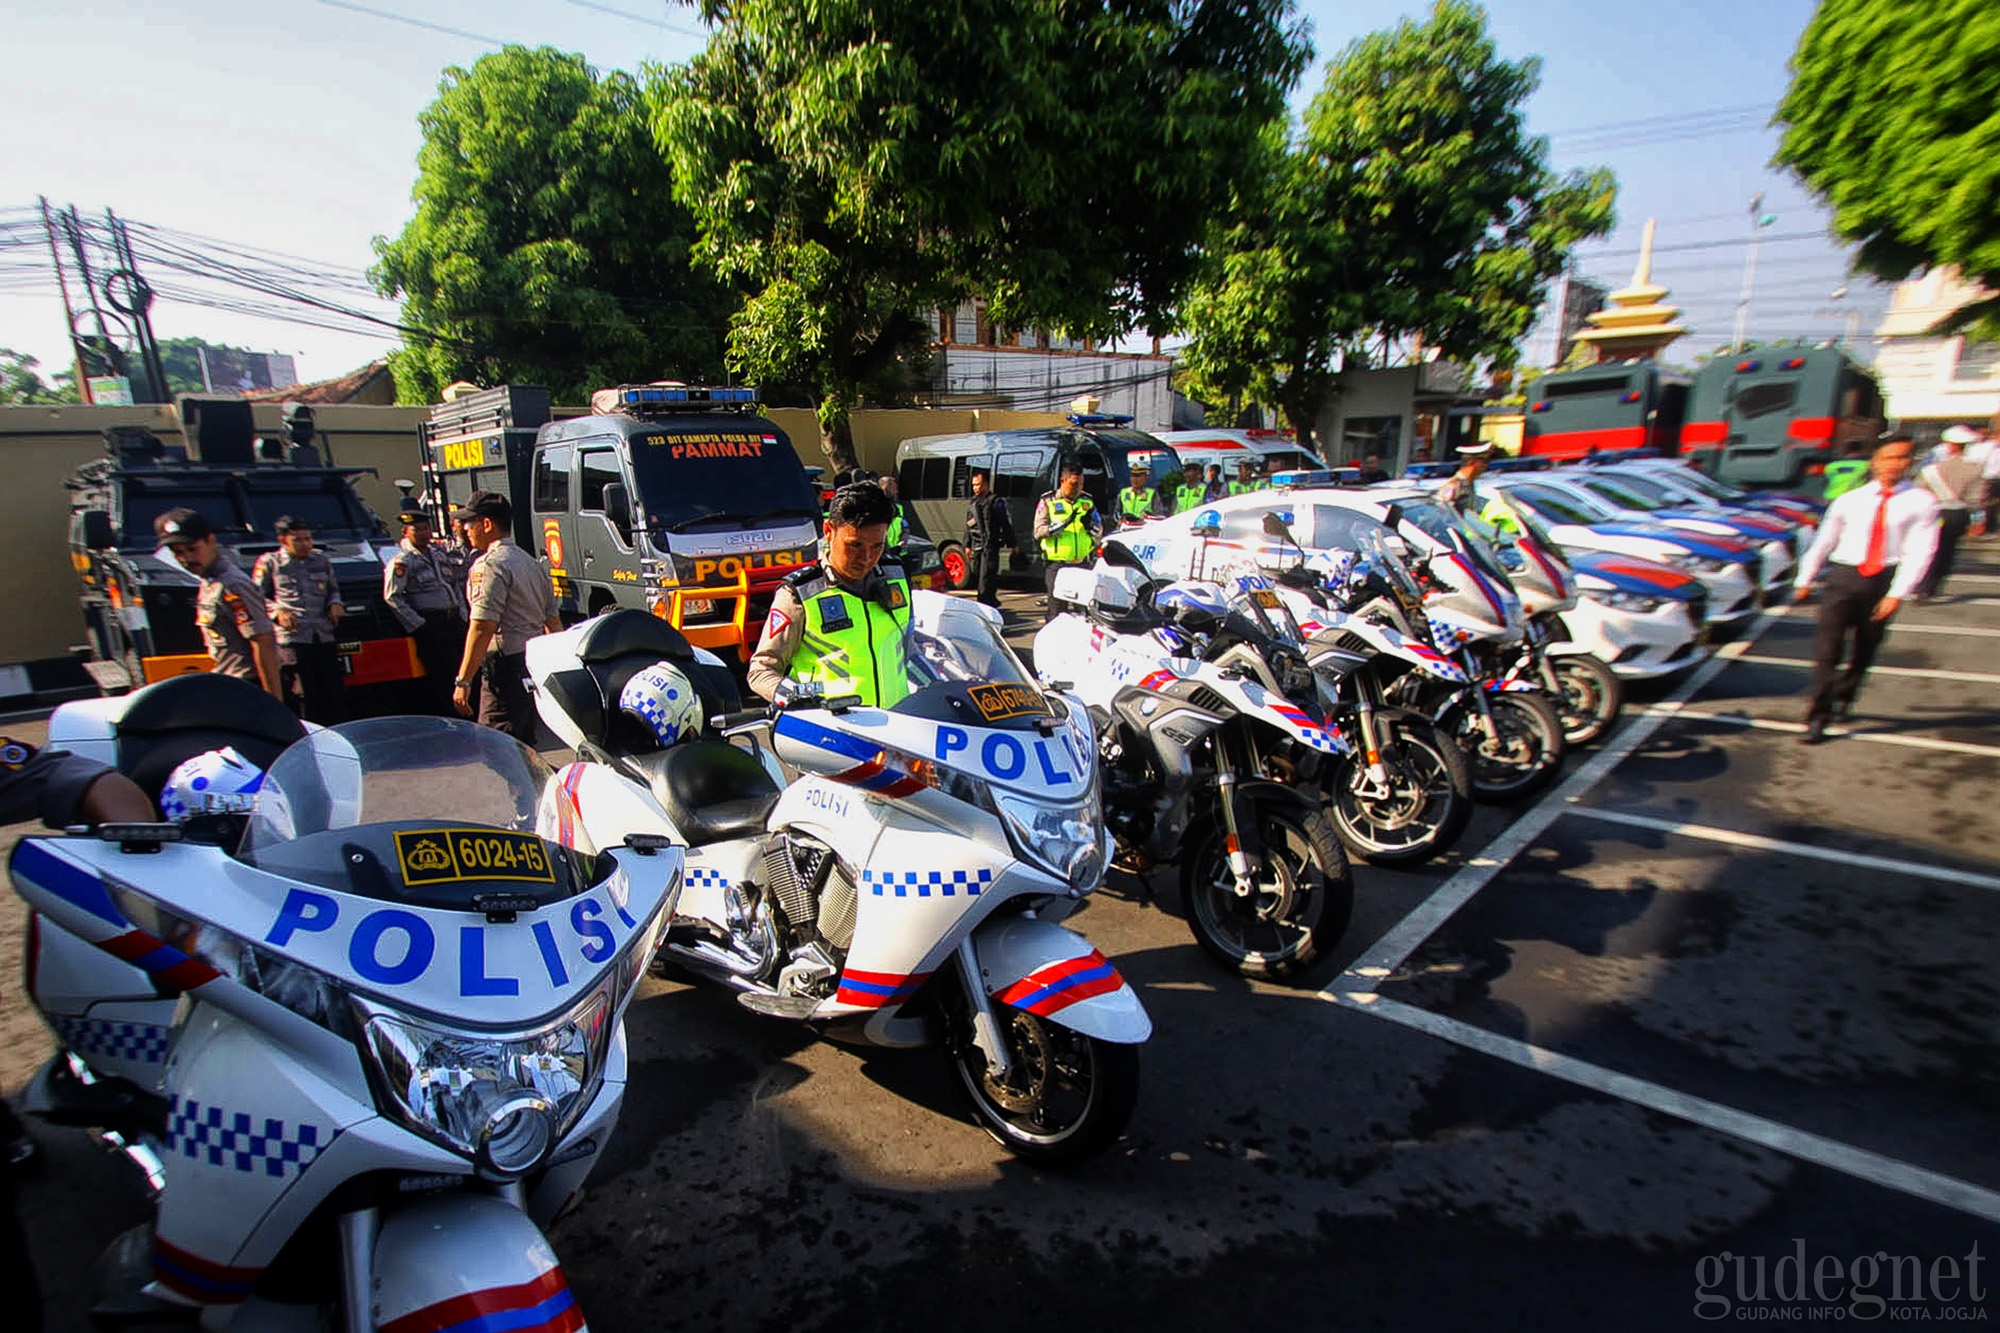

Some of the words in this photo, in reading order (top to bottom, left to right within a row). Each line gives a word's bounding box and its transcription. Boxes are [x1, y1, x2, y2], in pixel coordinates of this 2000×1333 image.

[444, 439, 484, 470] POLISI
[671, 443, 762, 459] PAMMAT
[725, 532, 774, 544] ISUZU
[459, 837, 544, 871] 6024-15
[264, 885, 637, 997] POLISI
